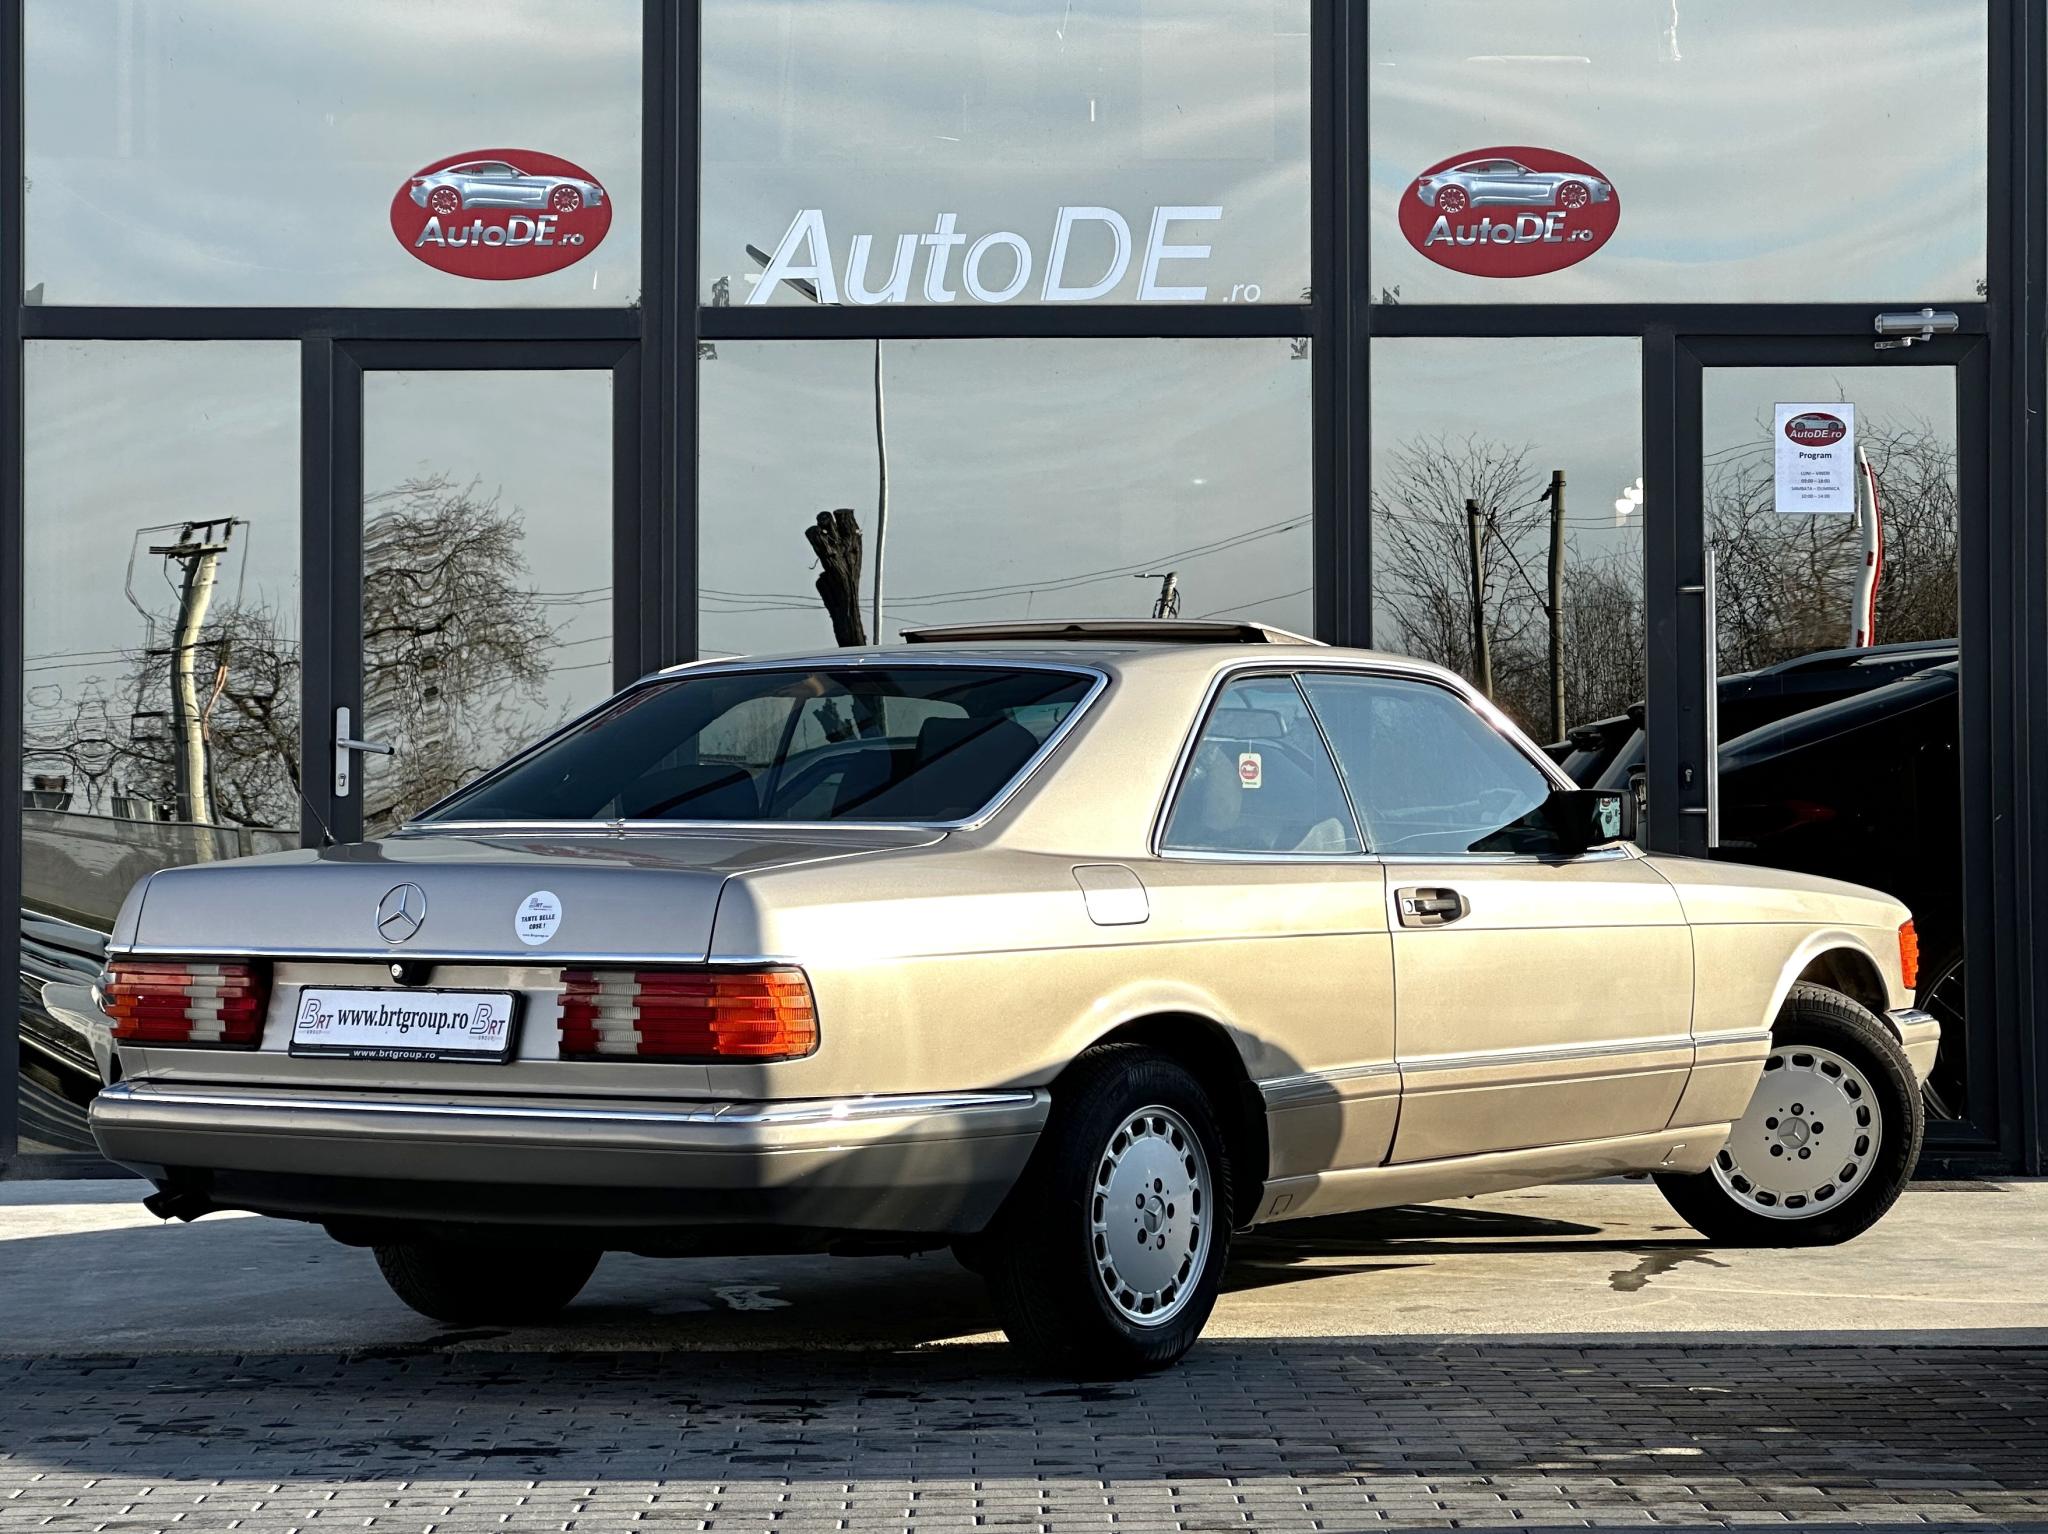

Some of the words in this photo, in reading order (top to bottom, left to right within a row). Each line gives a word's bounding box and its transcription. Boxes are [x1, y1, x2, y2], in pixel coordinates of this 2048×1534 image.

[1789, 429, 1842, 439] AutoDE.ro
[1799, 451, 1832, 460] Program
[337, 1004, 469, 1035] www.brtgroup.ro
[353, 1049, 437, 1061] www.brtgroup.ro
